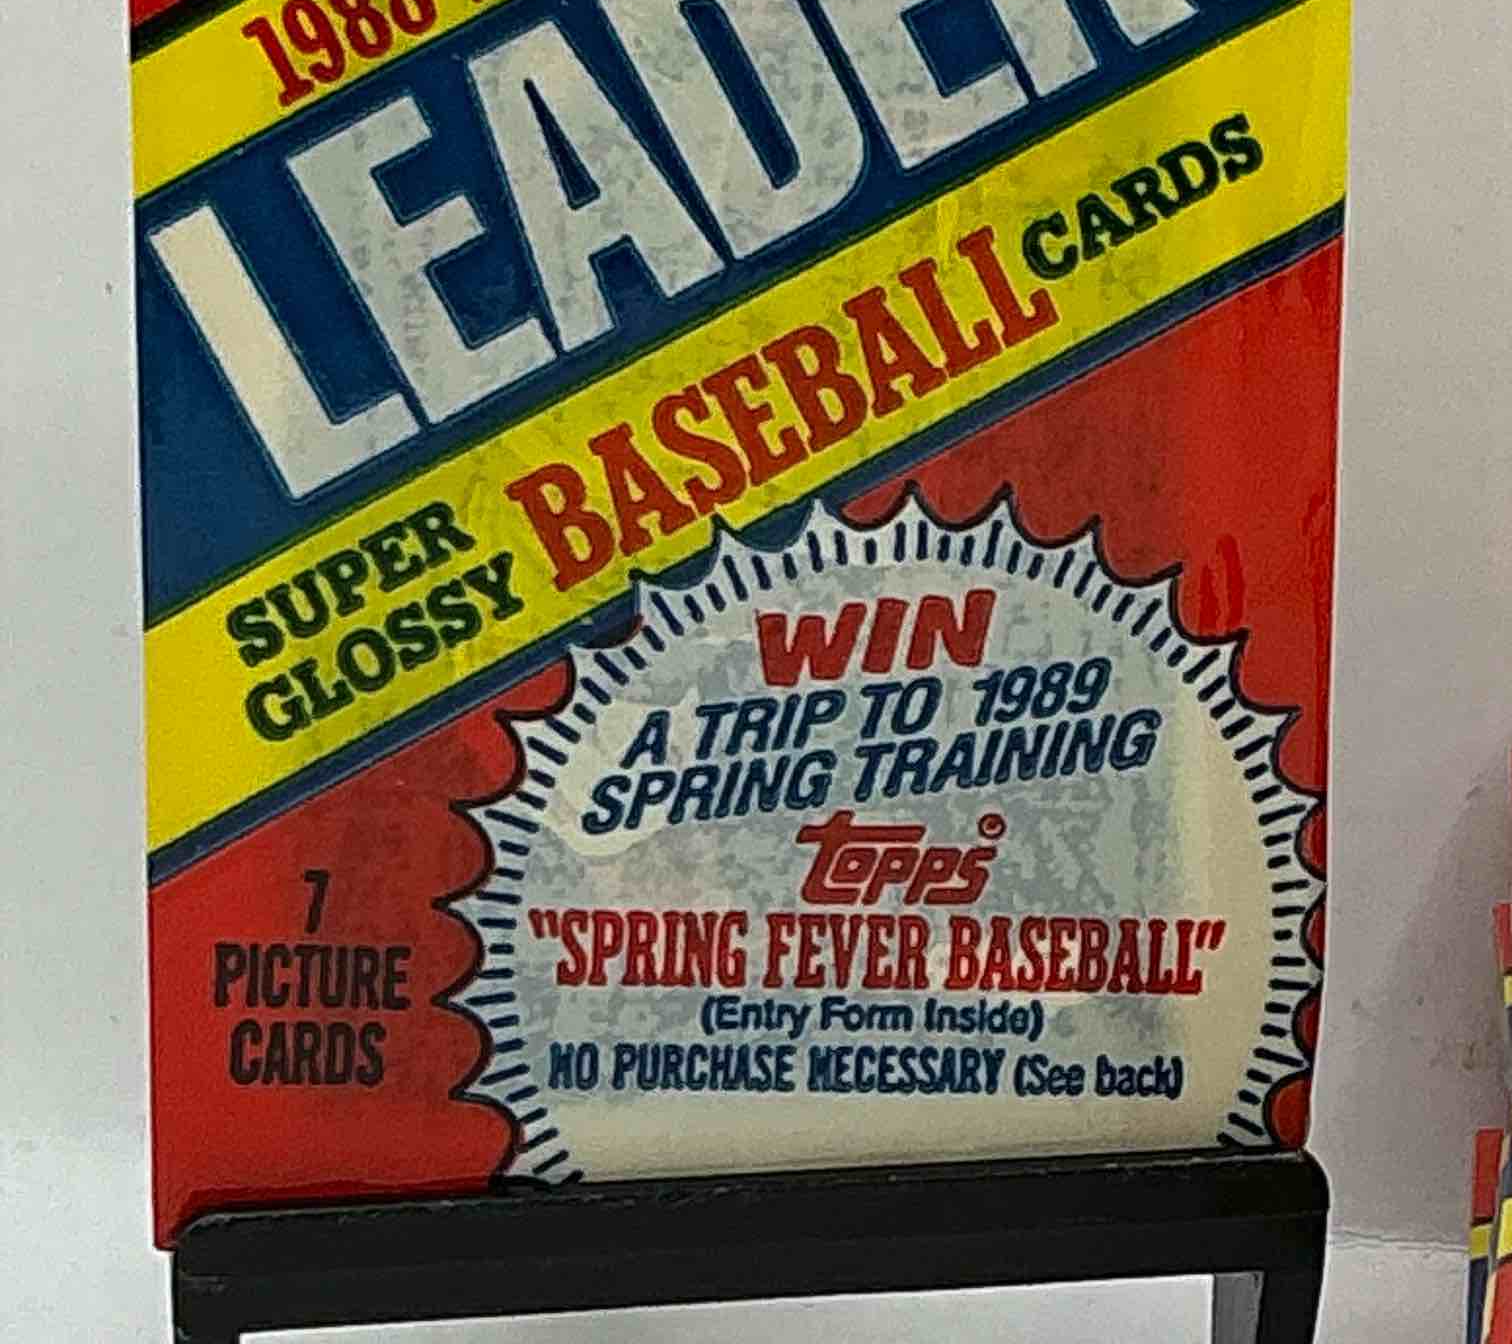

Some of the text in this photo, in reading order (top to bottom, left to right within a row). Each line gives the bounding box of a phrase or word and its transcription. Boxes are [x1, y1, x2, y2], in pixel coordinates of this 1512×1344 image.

[505, 113, 1264, 593] BASEBALL CARDS
[226, 500, 476, 667] SUPER
[244, 552, 524, 742] GLOSSY
[755, 588, 997, 688] WIN
[620, 657, 1112, 770] A TRIP TO 1989
[582, 709, 1162, 835] SPRING TRAINING
[302, 868, 332, 935] 7
[212, 941, 413, 1011] PICTURE
[527, 908, 1227, 997] "SPRING FEVER BASEBALL"
[229, 1017, 388, 1087] CARDS
[700, 995, 1045, 1042] (Entry Form Inside)
[547, 1041, 1185, 1100] NO PURCHASE NECESSARY (See back)
